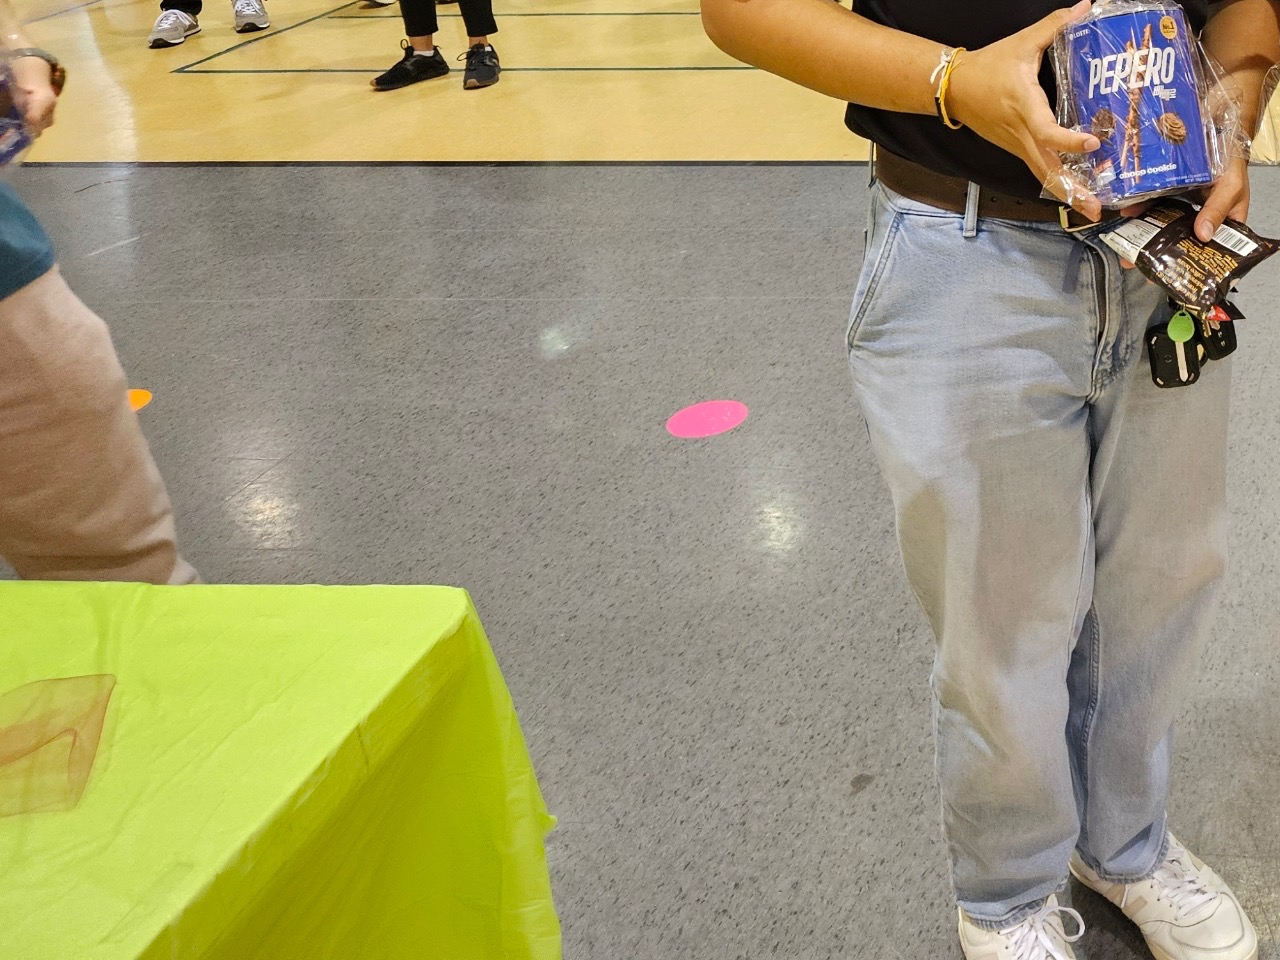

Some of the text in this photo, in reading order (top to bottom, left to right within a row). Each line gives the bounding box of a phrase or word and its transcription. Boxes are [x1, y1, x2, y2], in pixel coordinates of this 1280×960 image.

[1088, 46, 1176, 99] PEPERO
[1119, 162, 1177, 179] choco cookie
